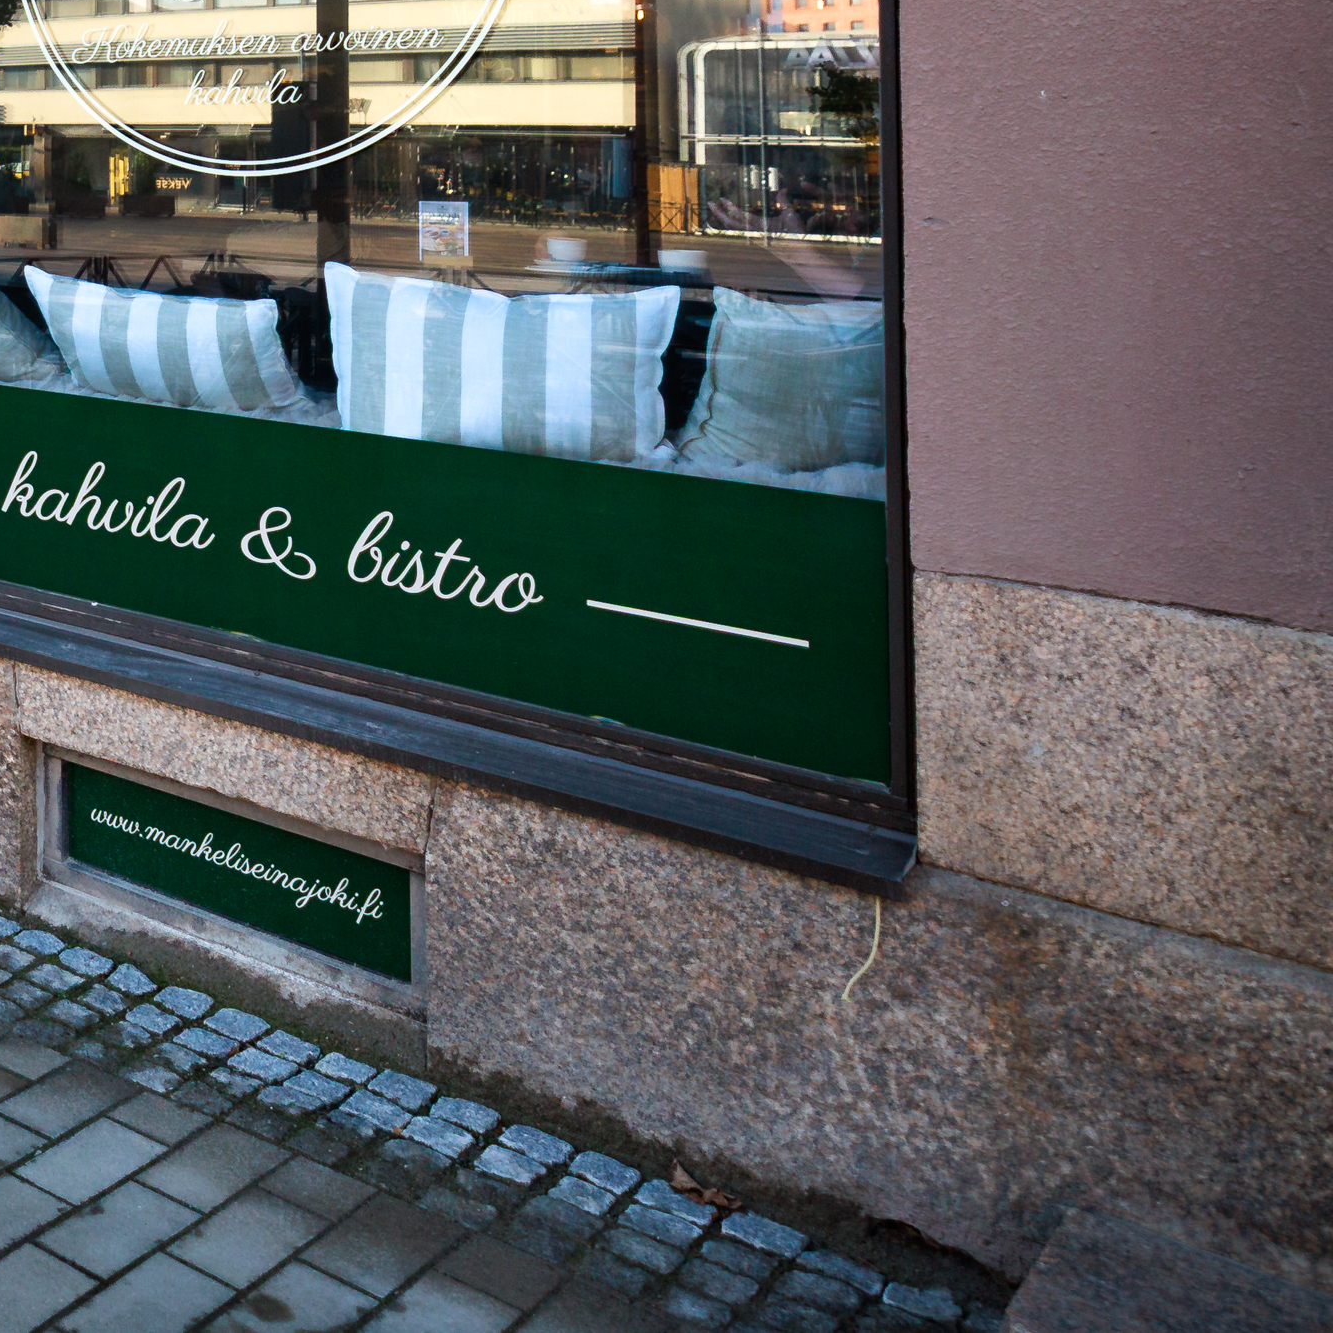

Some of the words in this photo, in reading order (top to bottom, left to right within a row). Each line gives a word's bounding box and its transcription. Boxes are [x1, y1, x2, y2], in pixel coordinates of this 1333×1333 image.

[71, 19, 281, 66] Kokemuksen
[290, 24, 446, 52] arvoinen
[184, 68, 303, 106] kahvila
[1, 450, 216, 550] kahvila
[240, 505, 318, 580] &
[347, 510, 545, 614] bistro
[90, 807, 383, 925] www.mankeliseinajoki.fi
